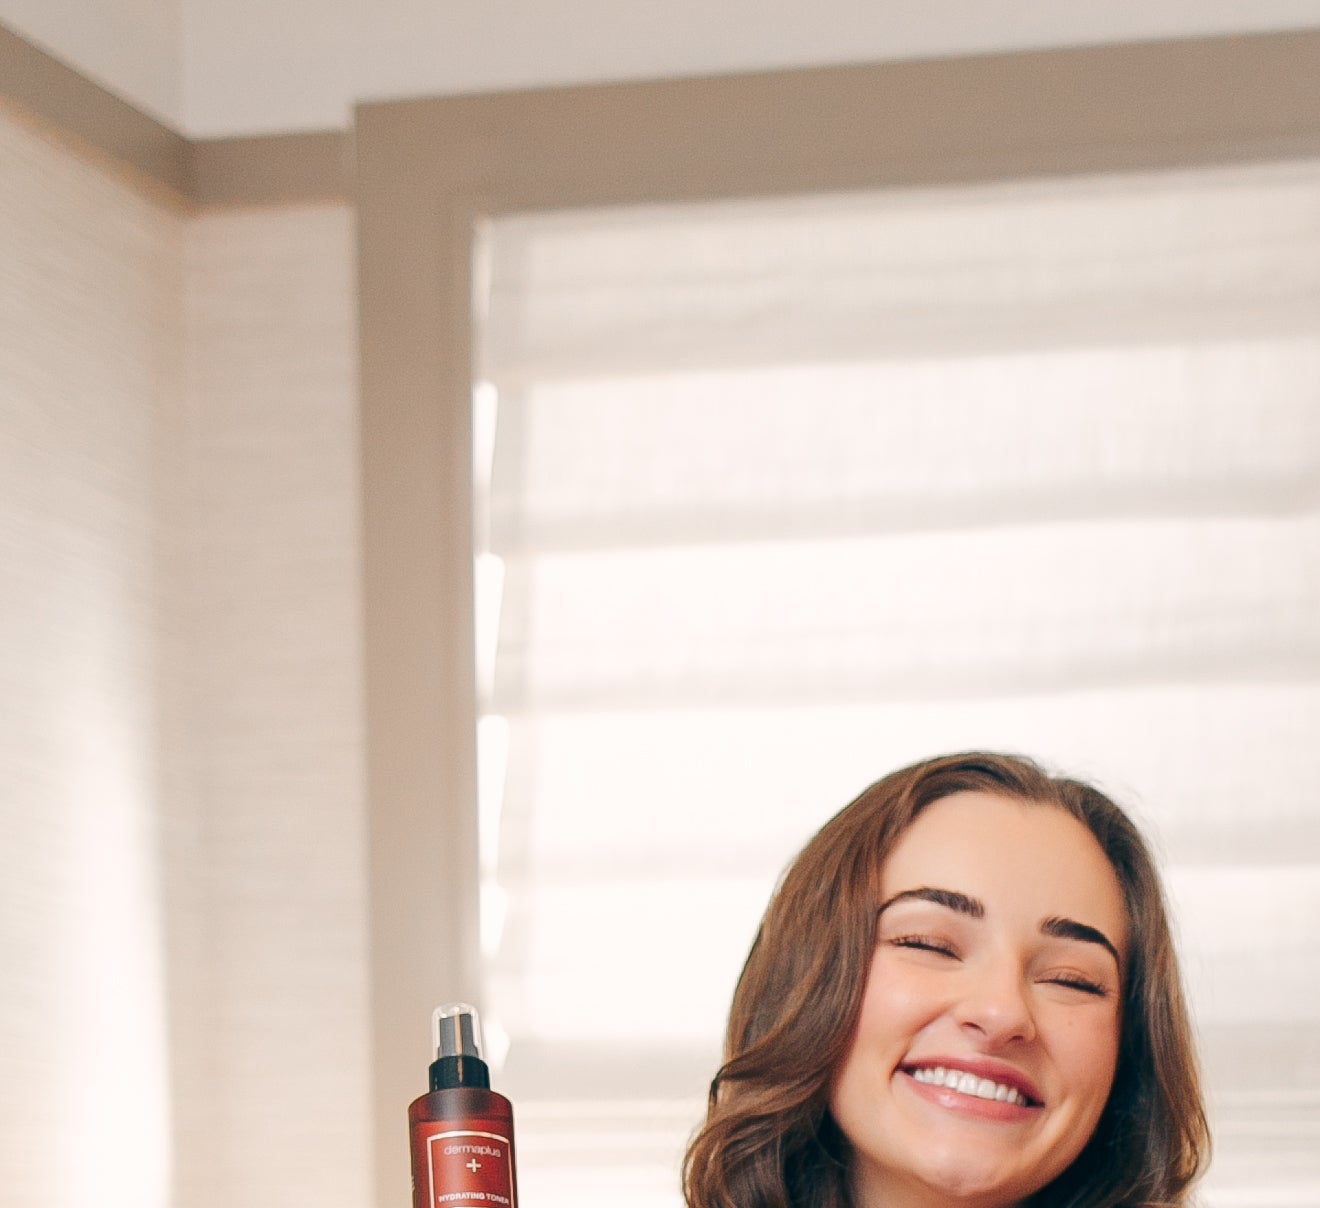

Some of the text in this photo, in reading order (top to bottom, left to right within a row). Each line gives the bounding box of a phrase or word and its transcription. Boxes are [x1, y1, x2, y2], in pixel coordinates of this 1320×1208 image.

[444, 1144, 502, 1158] dermaplus
[438, 1191, 510, 1205] HYDRATING TONER
